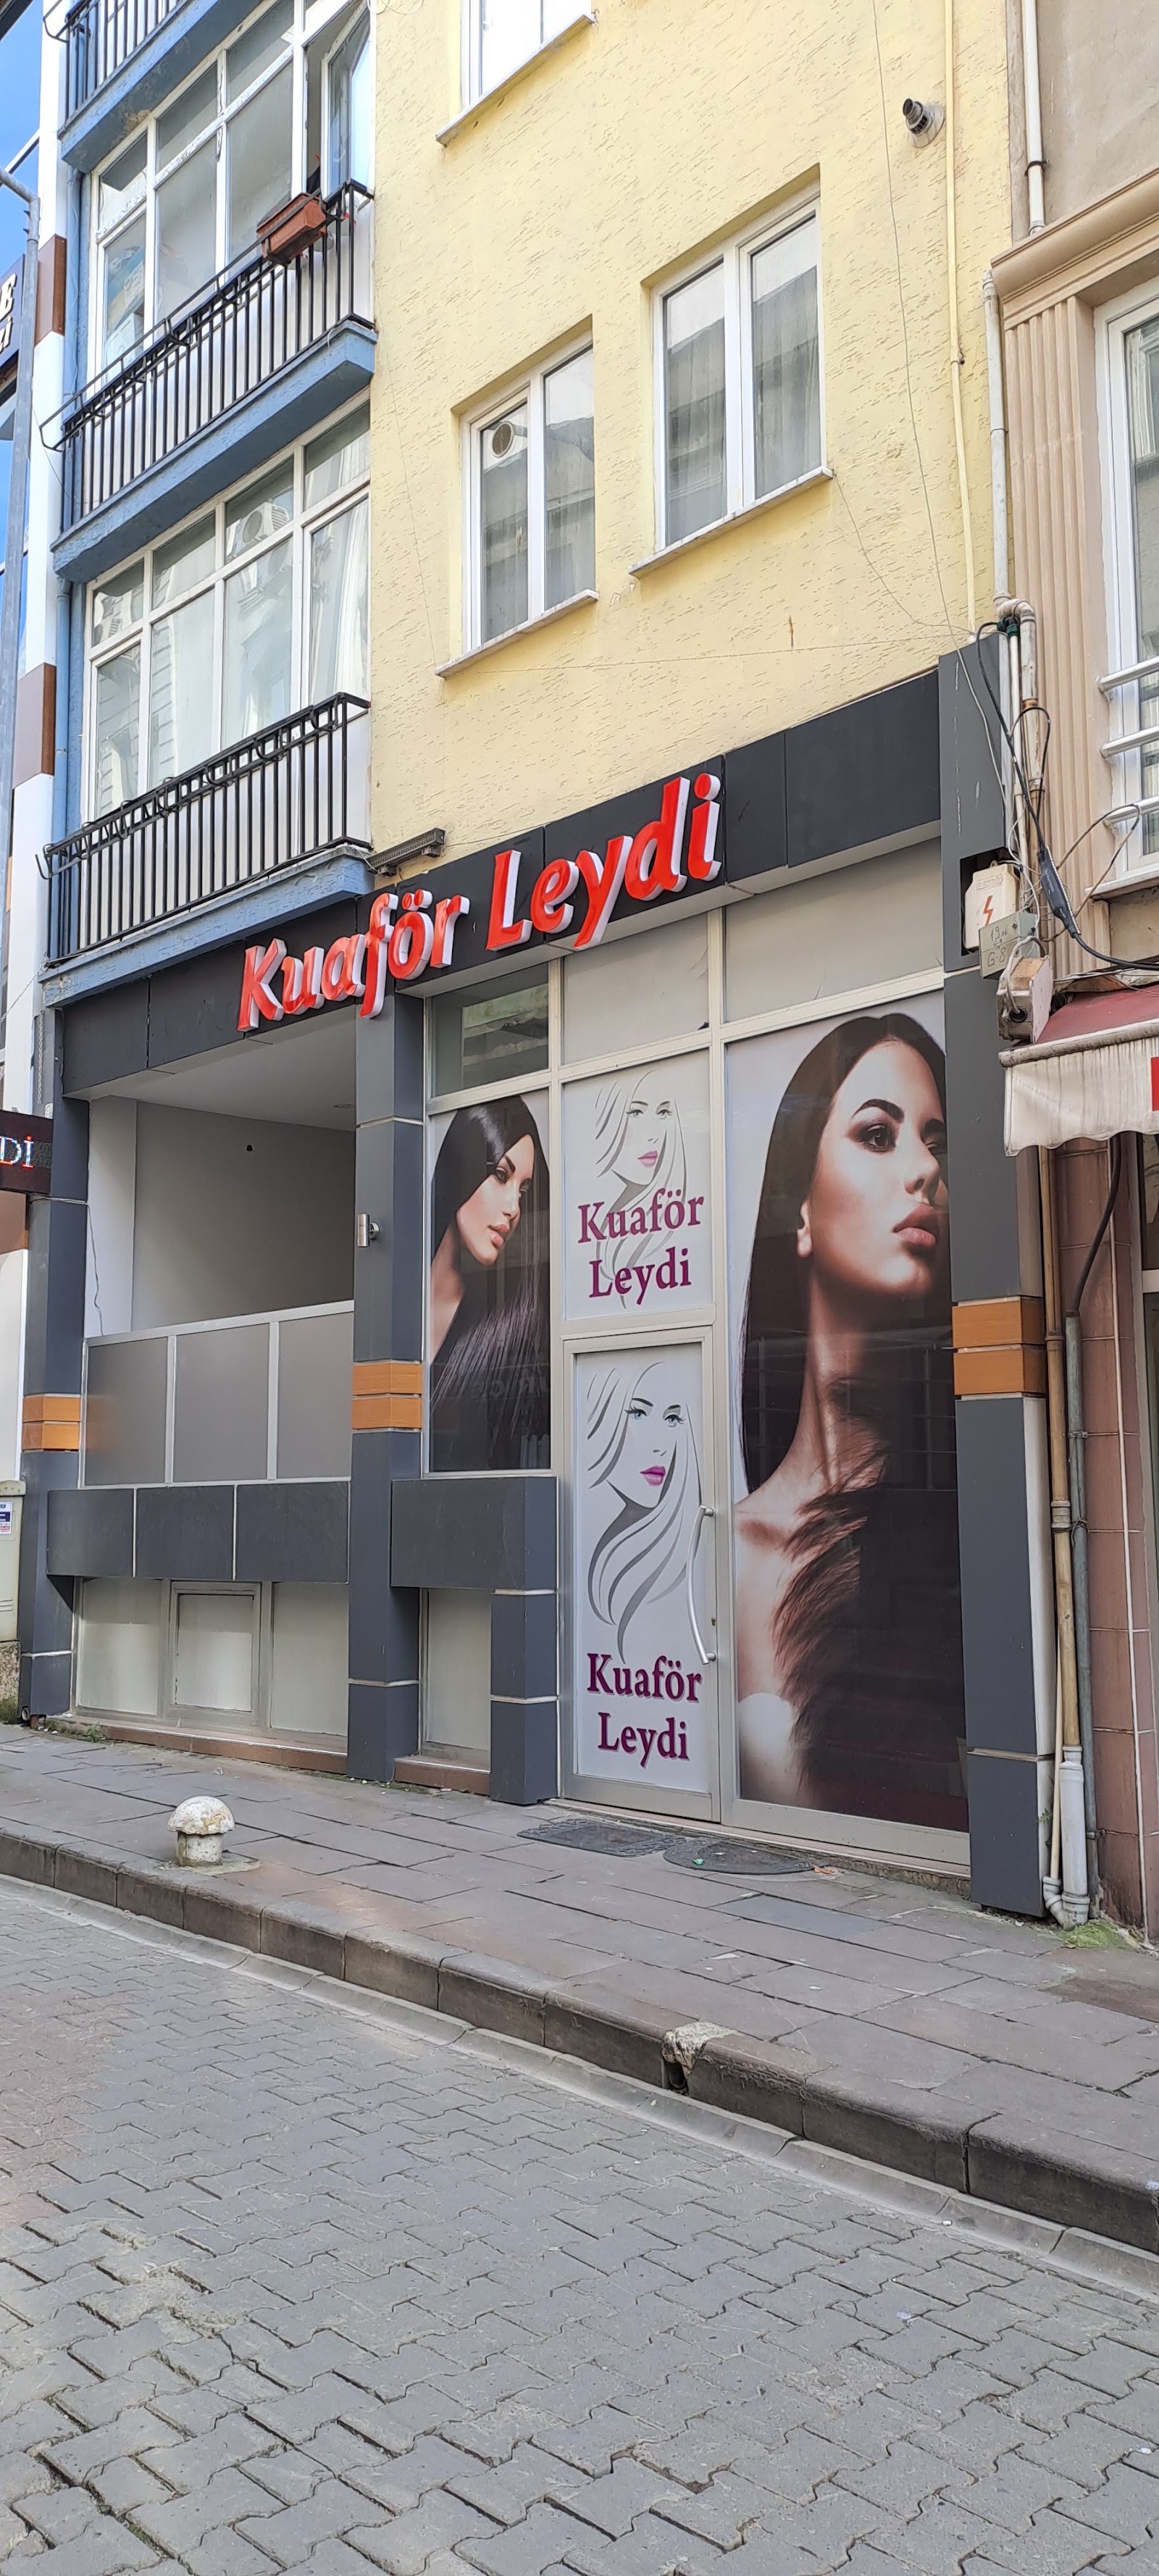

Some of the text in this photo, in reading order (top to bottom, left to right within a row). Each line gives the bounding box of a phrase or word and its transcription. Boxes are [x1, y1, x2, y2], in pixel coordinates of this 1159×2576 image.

[237, 772, 721, 1032] Kuaför Leydi
[577, 1187, 705, 1244] Kuaför
[588, 1246, 692, 1305] Leydi
[587, 1652, 703, 1703] Kuaför
[598, 1712, 690, 1768] Leydi
